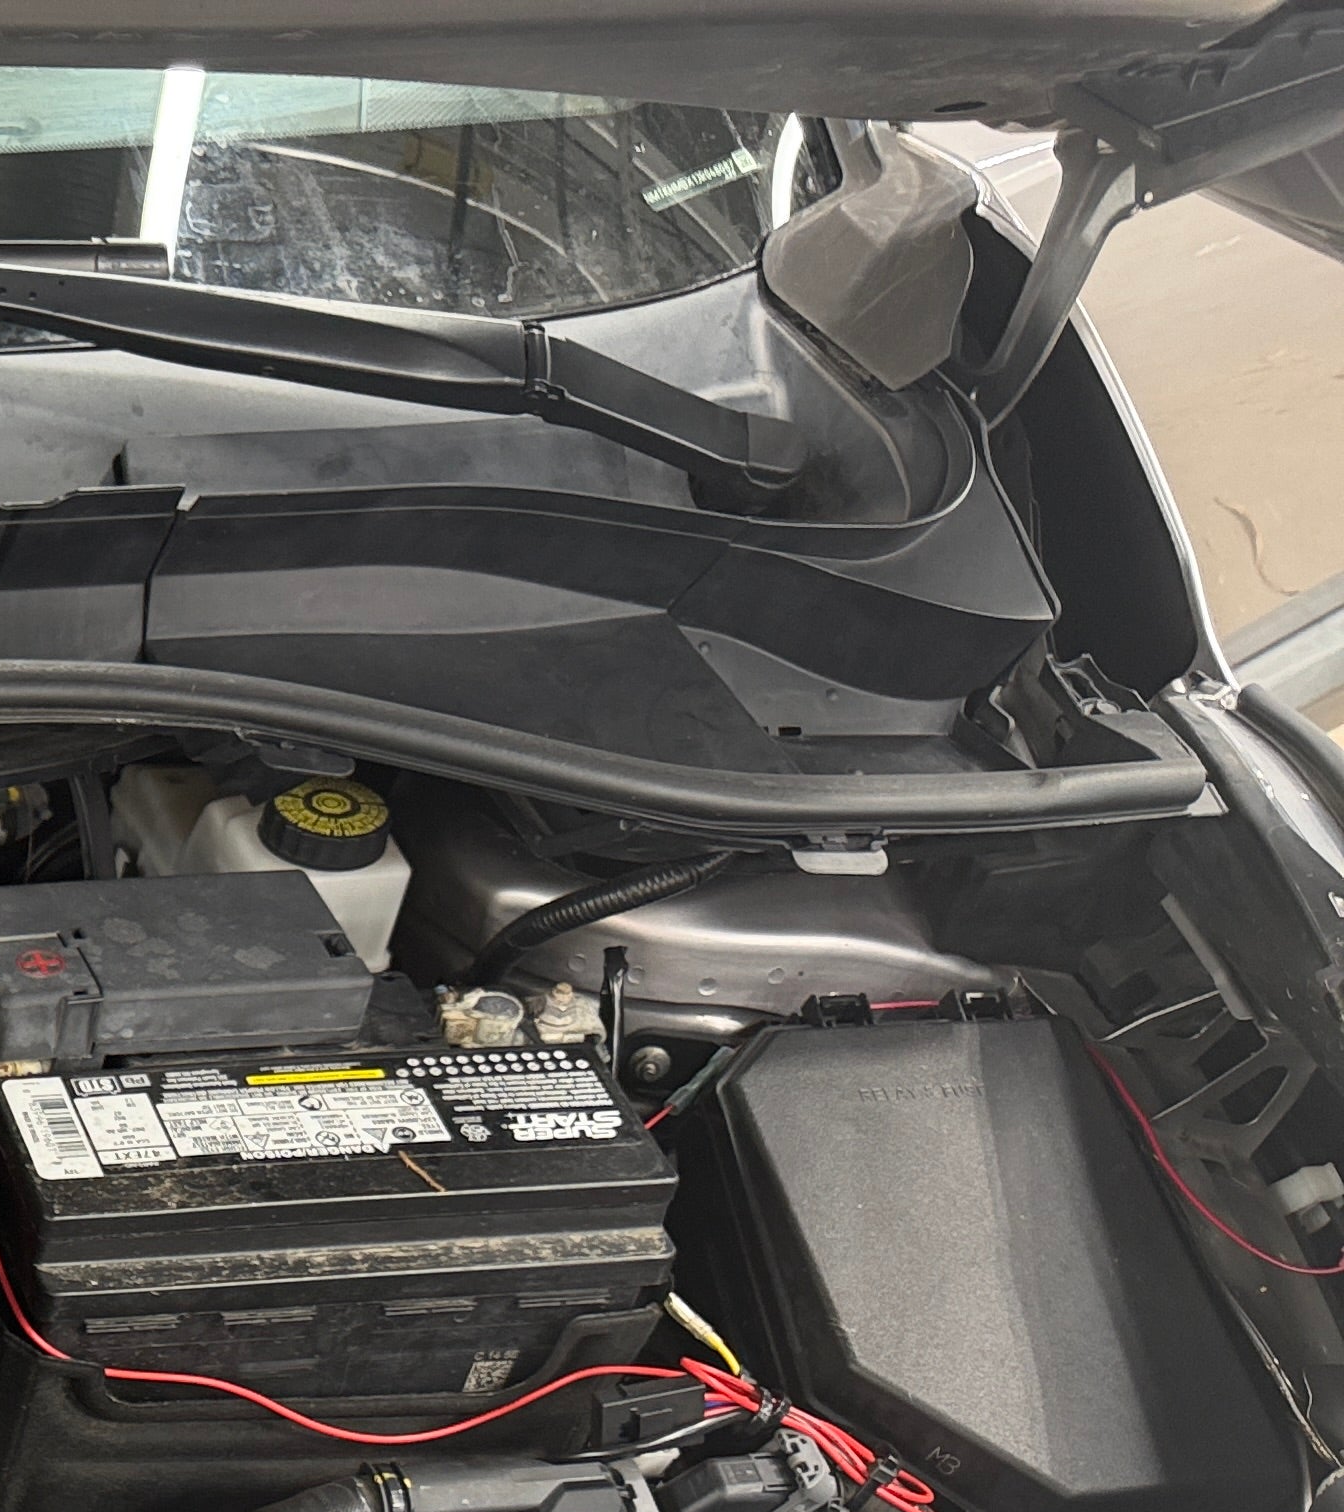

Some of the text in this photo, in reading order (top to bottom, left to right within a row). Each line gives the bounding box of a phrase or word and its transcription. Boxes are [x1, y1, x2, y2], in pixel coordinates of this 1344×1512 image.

[513, 1110, 622, 1129] START
[512, 1126, 619, 1142] SUPER
[111, 1149, 162, 1160] 47EXT
[241, 1143, 376, 1162] DANGER/POISON
